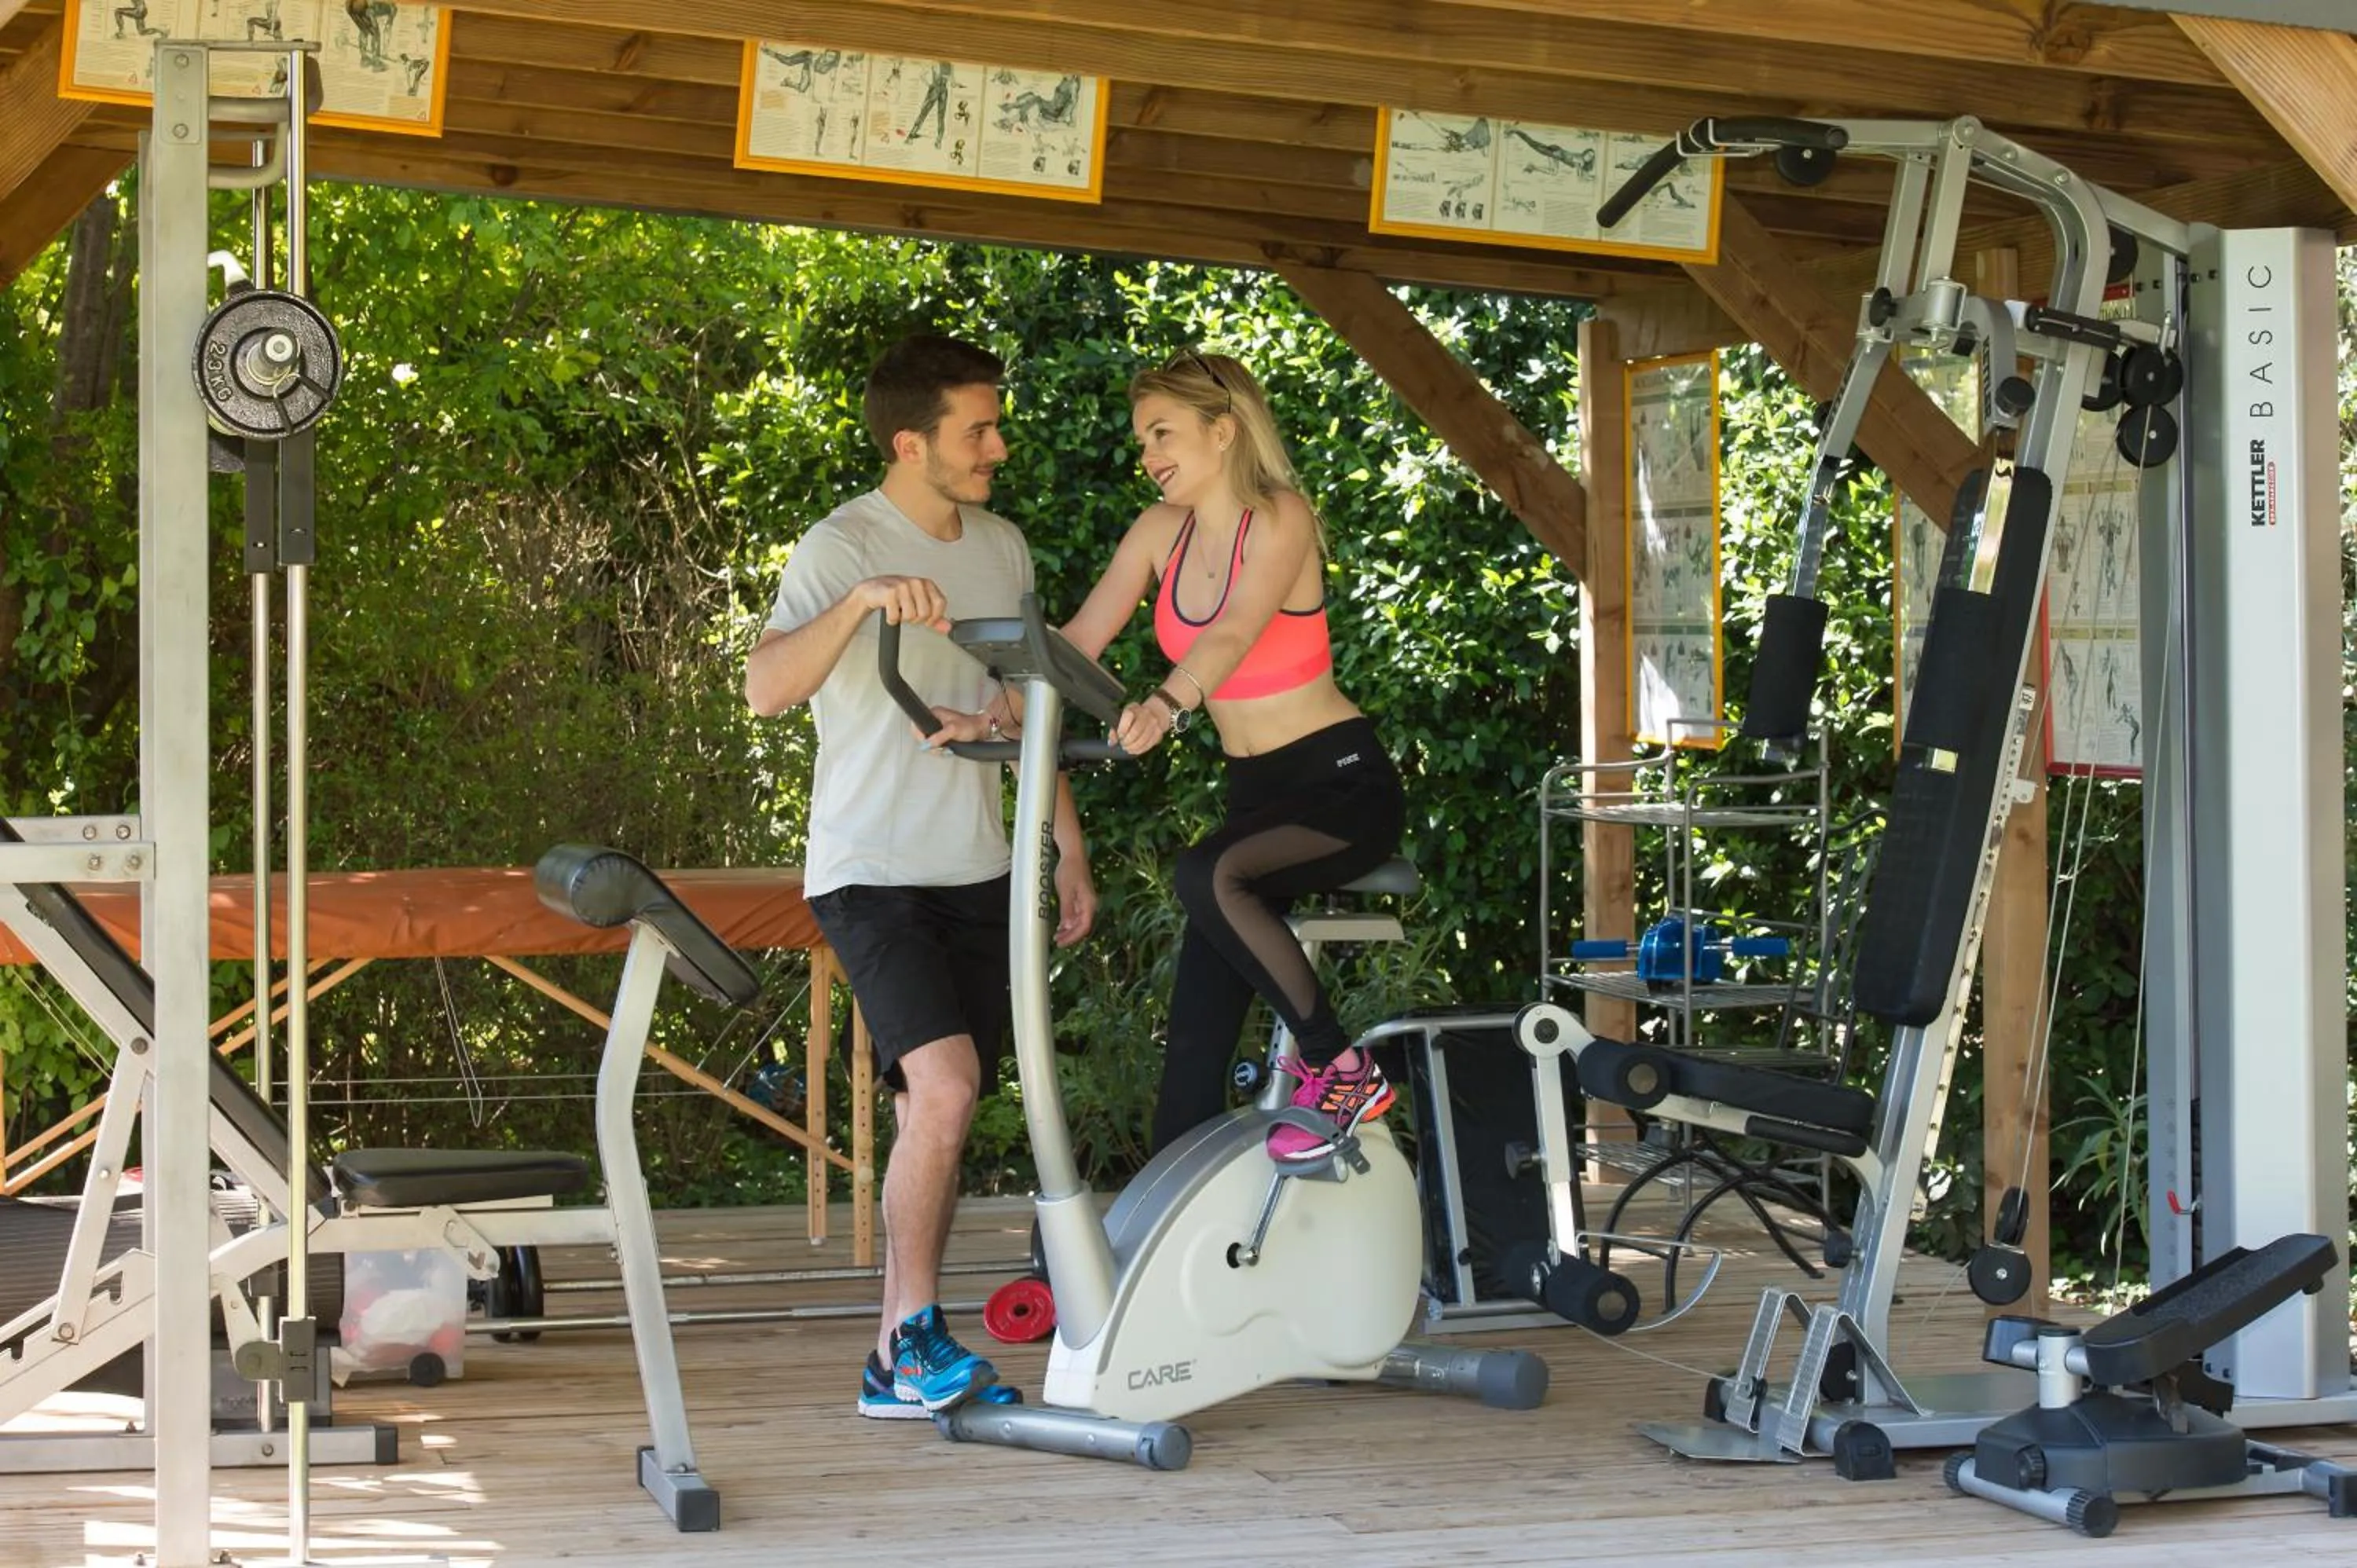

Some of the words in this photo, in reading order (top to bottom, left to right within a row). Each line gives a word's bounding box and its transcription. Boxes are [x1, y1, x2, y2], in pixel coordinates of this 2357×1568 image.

[2248, 266, 2273, 417] BASIC
[2250, 439, 2265, 526] KETTLER
[1039, 821, 1054, 918] BOOSTER
[1128, 1361, 1192, 1390] CARE
